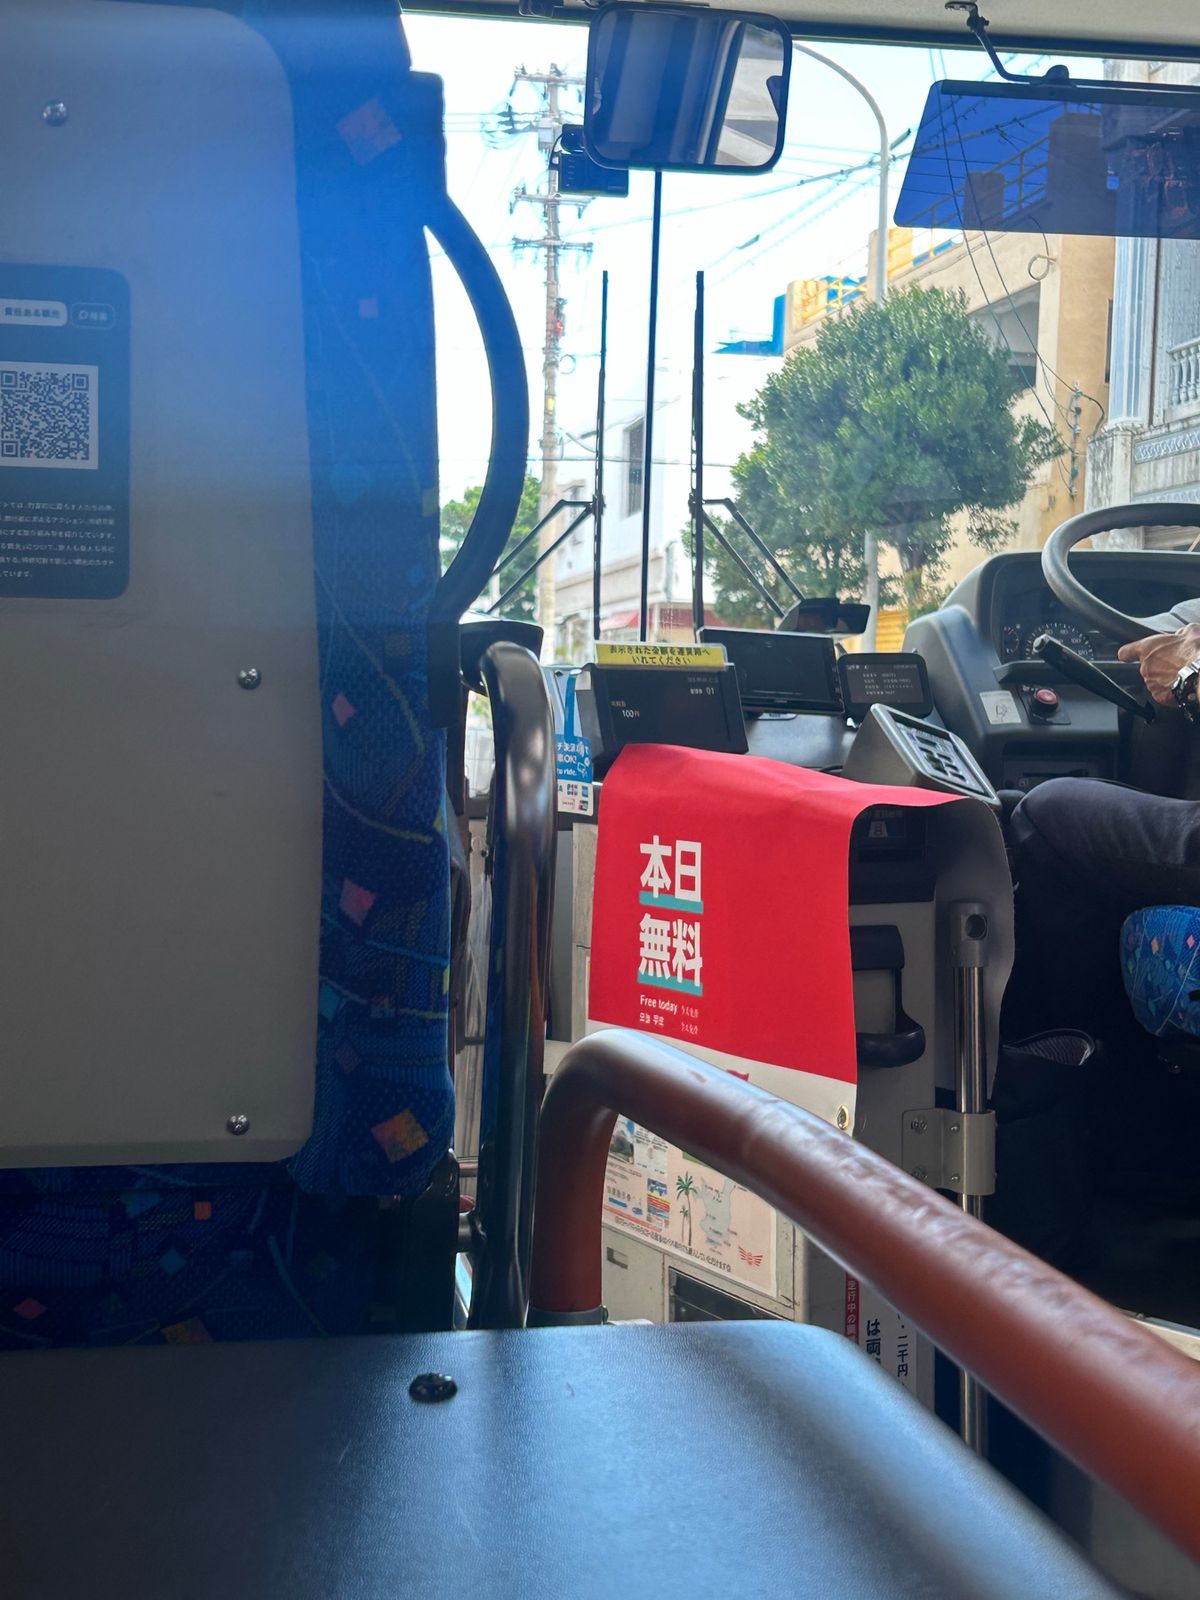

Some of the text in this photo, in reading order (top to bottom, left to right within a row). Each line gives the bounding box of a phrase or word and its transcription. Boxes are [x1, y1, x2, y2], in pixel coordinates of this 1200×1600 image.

[632, 655, 692, 666] いれてください
[639, 834, 703, 902] 本日
[638, 912, 703, 987] 無料
[640, 994, 678, 1016] Free today
[865, 1318, 881, 1363] は両
